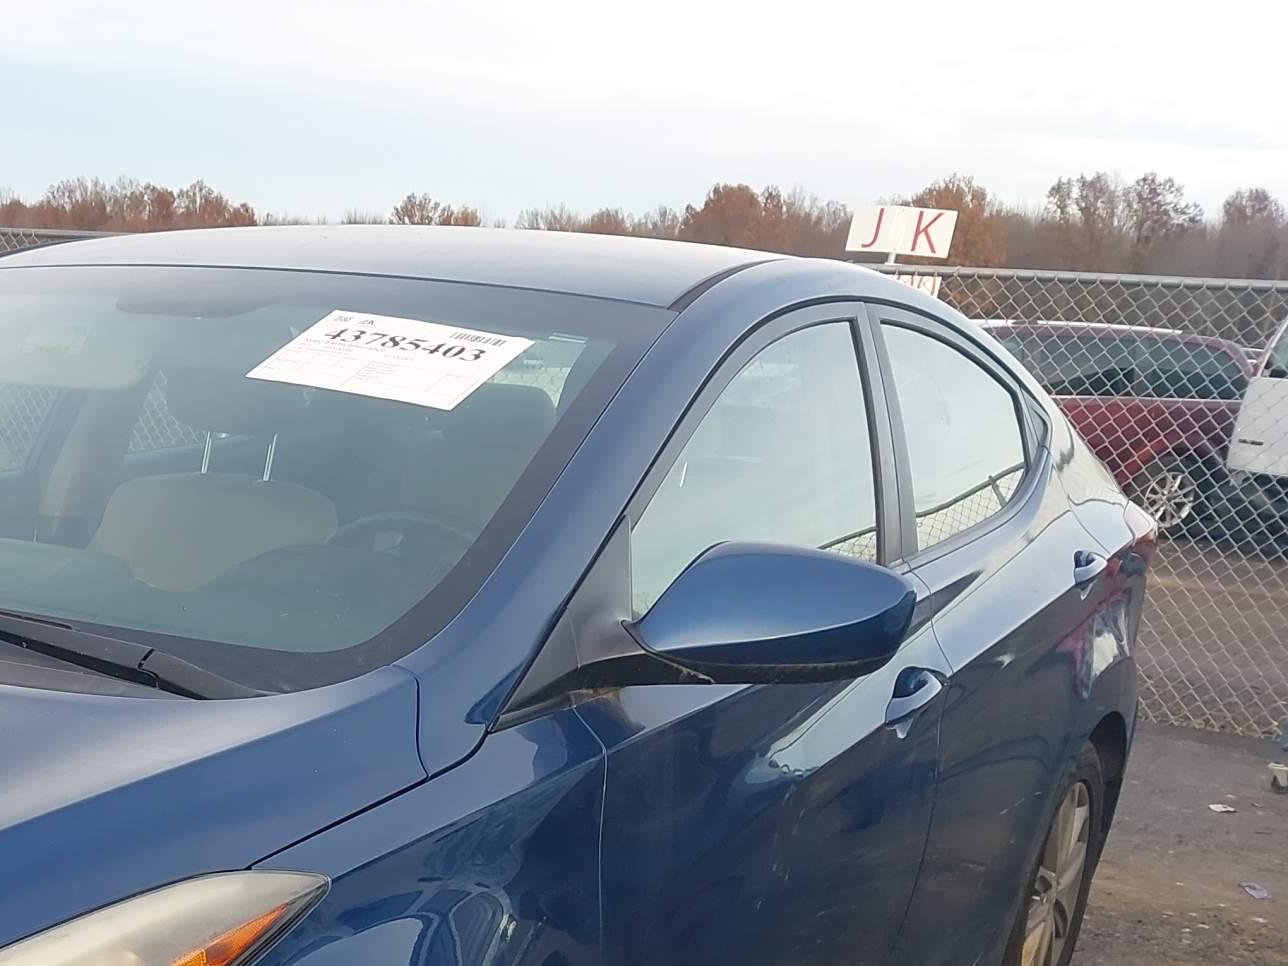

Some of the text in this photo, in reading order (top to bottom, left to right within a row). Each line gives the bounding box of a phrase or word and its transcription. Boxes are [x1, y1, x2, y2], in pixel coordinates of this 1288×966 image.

[861, 207, 944, 254] J K
[324, 327, 487, 362] 43785403
